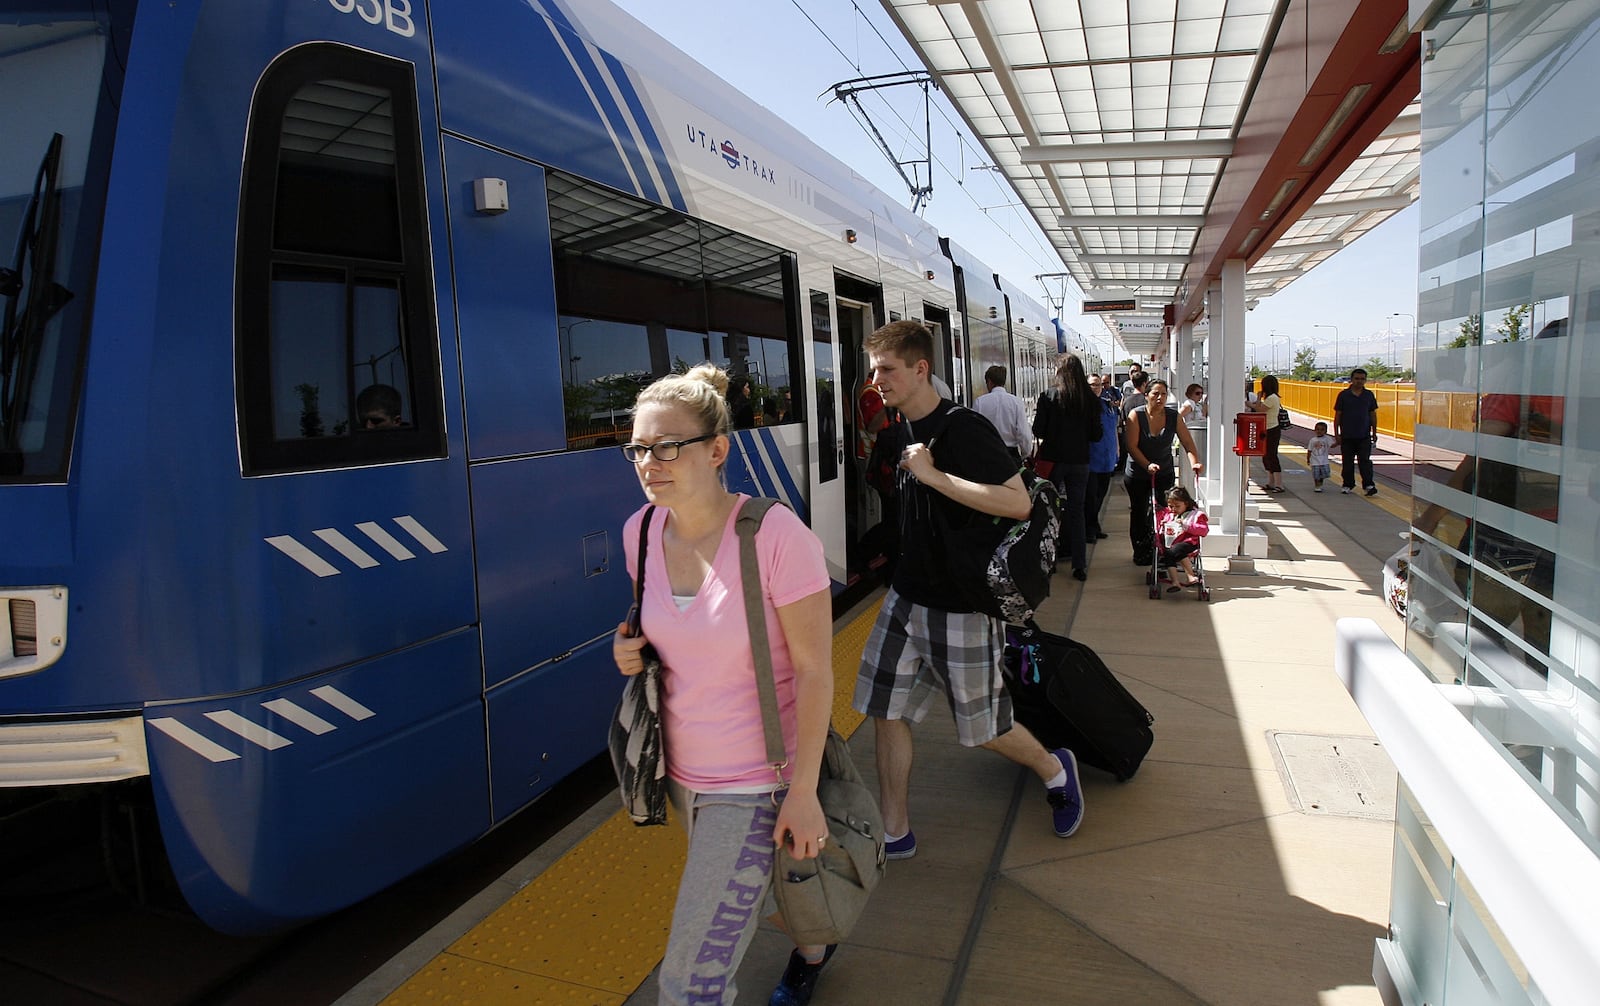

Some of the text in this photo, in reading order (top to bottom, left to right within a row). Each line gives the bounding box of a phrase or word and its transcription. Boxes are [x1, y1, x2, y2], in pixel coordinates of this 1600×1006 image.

[686, 123, 776, 185] UTA TRAX
[734, 805, 777, 877] INK
[695, 879, 763, 969] PINK
